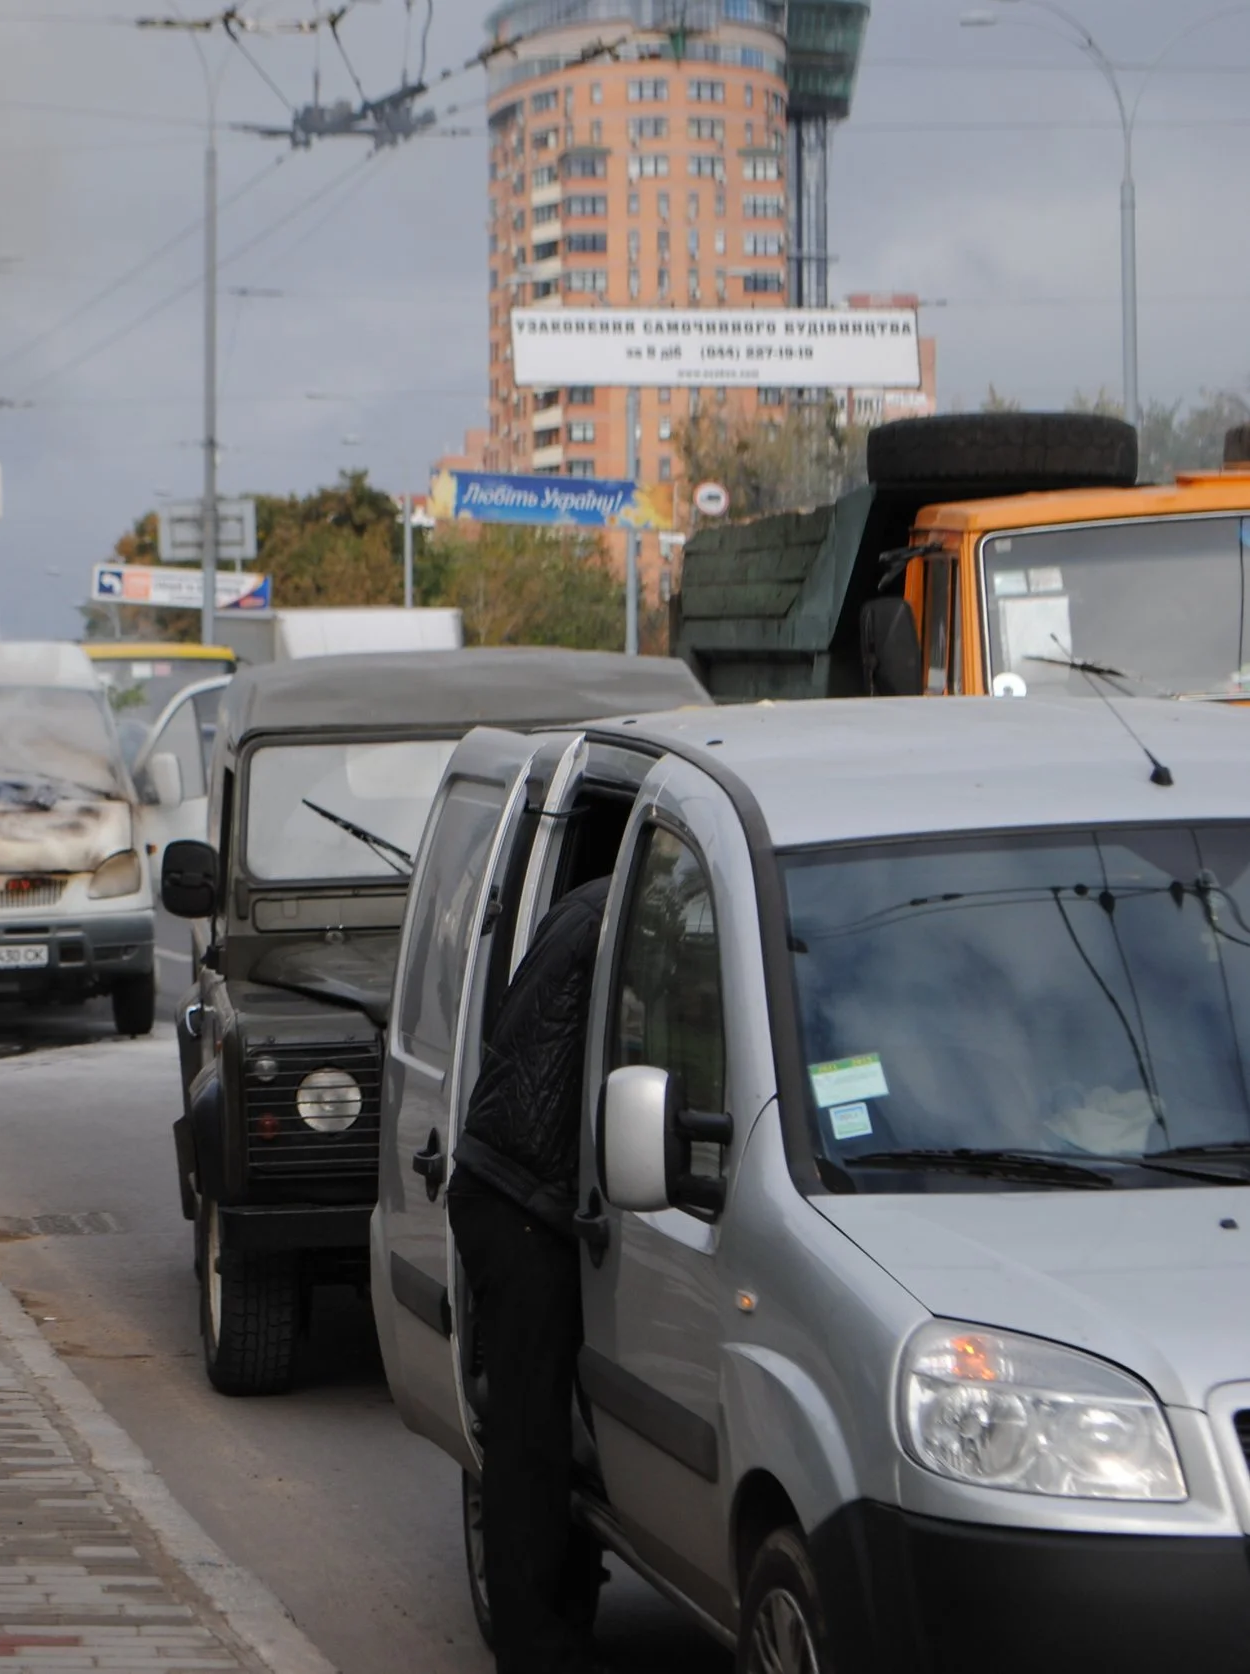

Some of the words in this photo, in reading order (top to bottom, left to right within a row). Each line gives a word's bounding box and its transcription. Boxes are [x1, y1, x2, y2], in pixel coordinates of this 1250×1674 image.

[516, 319, 635, 335] УЗАКОНЕННЯ
[643, 320, 776, 336] САМОЧИННОГО
[784, 320, 912, 339] БУДІВНИЦТВА
[462, 482, 539, 507] Любіть
[540, 486, 624, 515] Україну!
